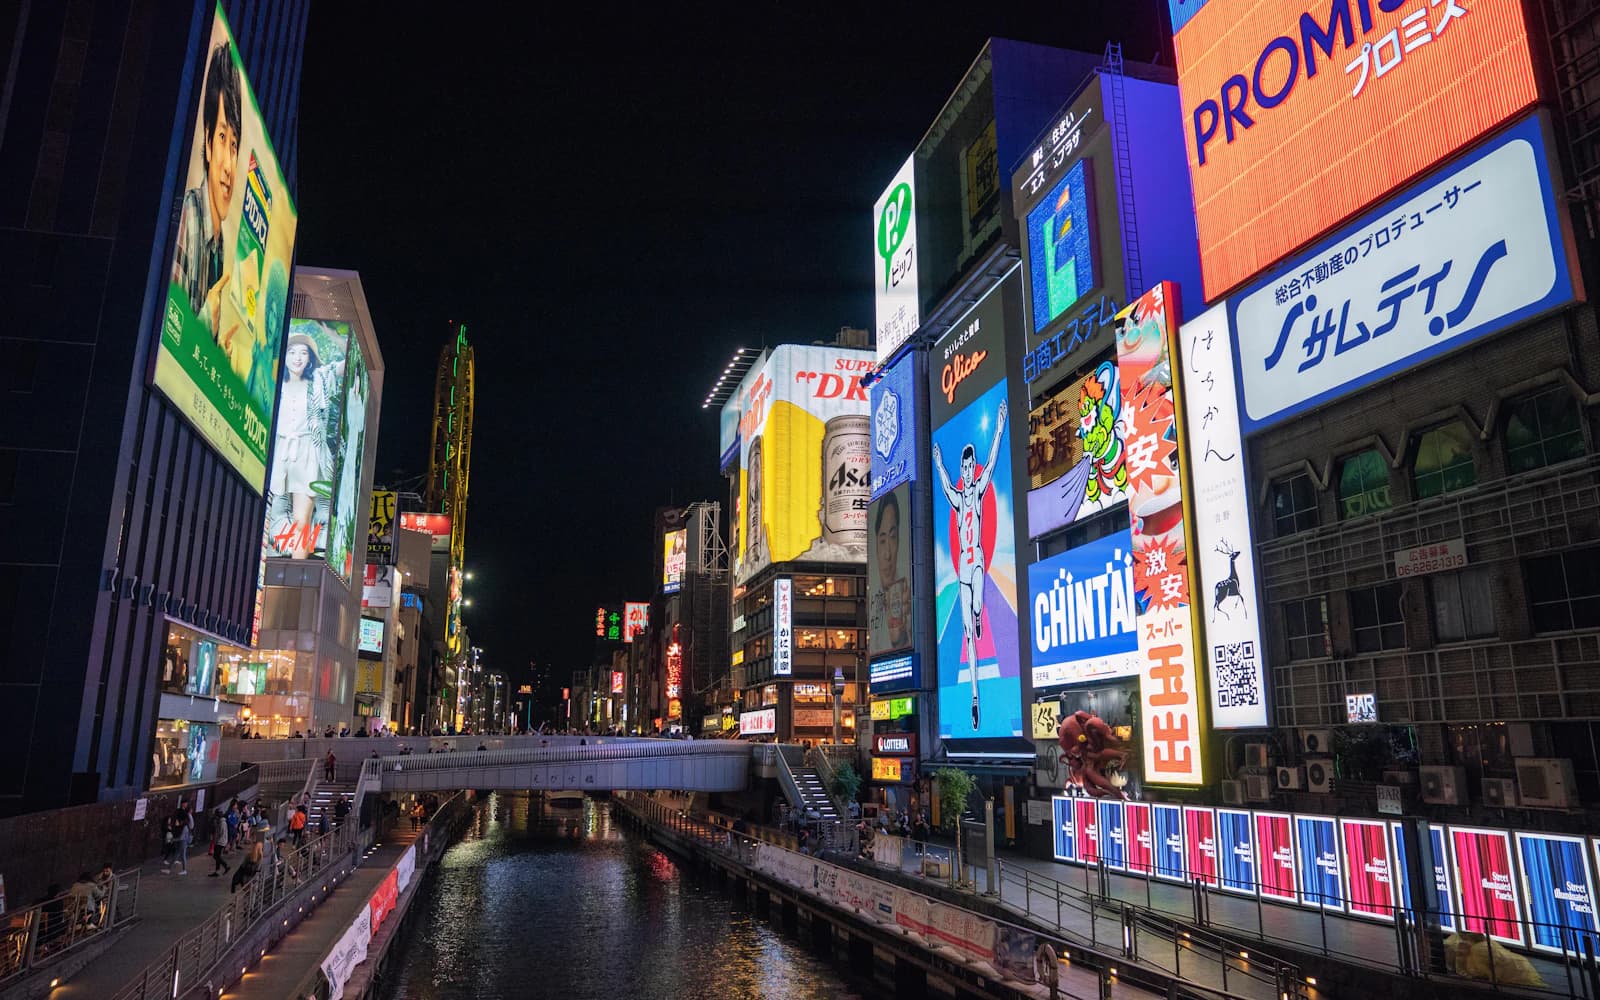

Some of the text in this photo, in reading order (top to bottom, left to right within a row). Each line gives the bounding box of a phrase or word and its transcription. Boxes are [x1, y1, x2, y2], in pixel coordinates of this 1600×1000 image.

[1345, 0, 1468, 98] プロミス
[1193, 0, 1403, 167] PROMI
[1275, 180, 1482, 305] 総合不動産のプロデューサー
[1023, 295, 1120, 384] 日商エステム
[941, 350, 988, 404] Glico
[272, 522, 323, 553] H&M
[965, 506, 975, 564] グリコ
[1035, 550, 1136, 653] CHINTAI
[1145, 547, 1183, 601] 激安
[1146, 618, 1183, 641] スーパー
[1148, 643, 1192, 774] 玉出
[1346, 694, 1376, 714] BAR
[883, 737, 909, 751] LOTTERIA
[1377, 786, 1401, 801] BAR
